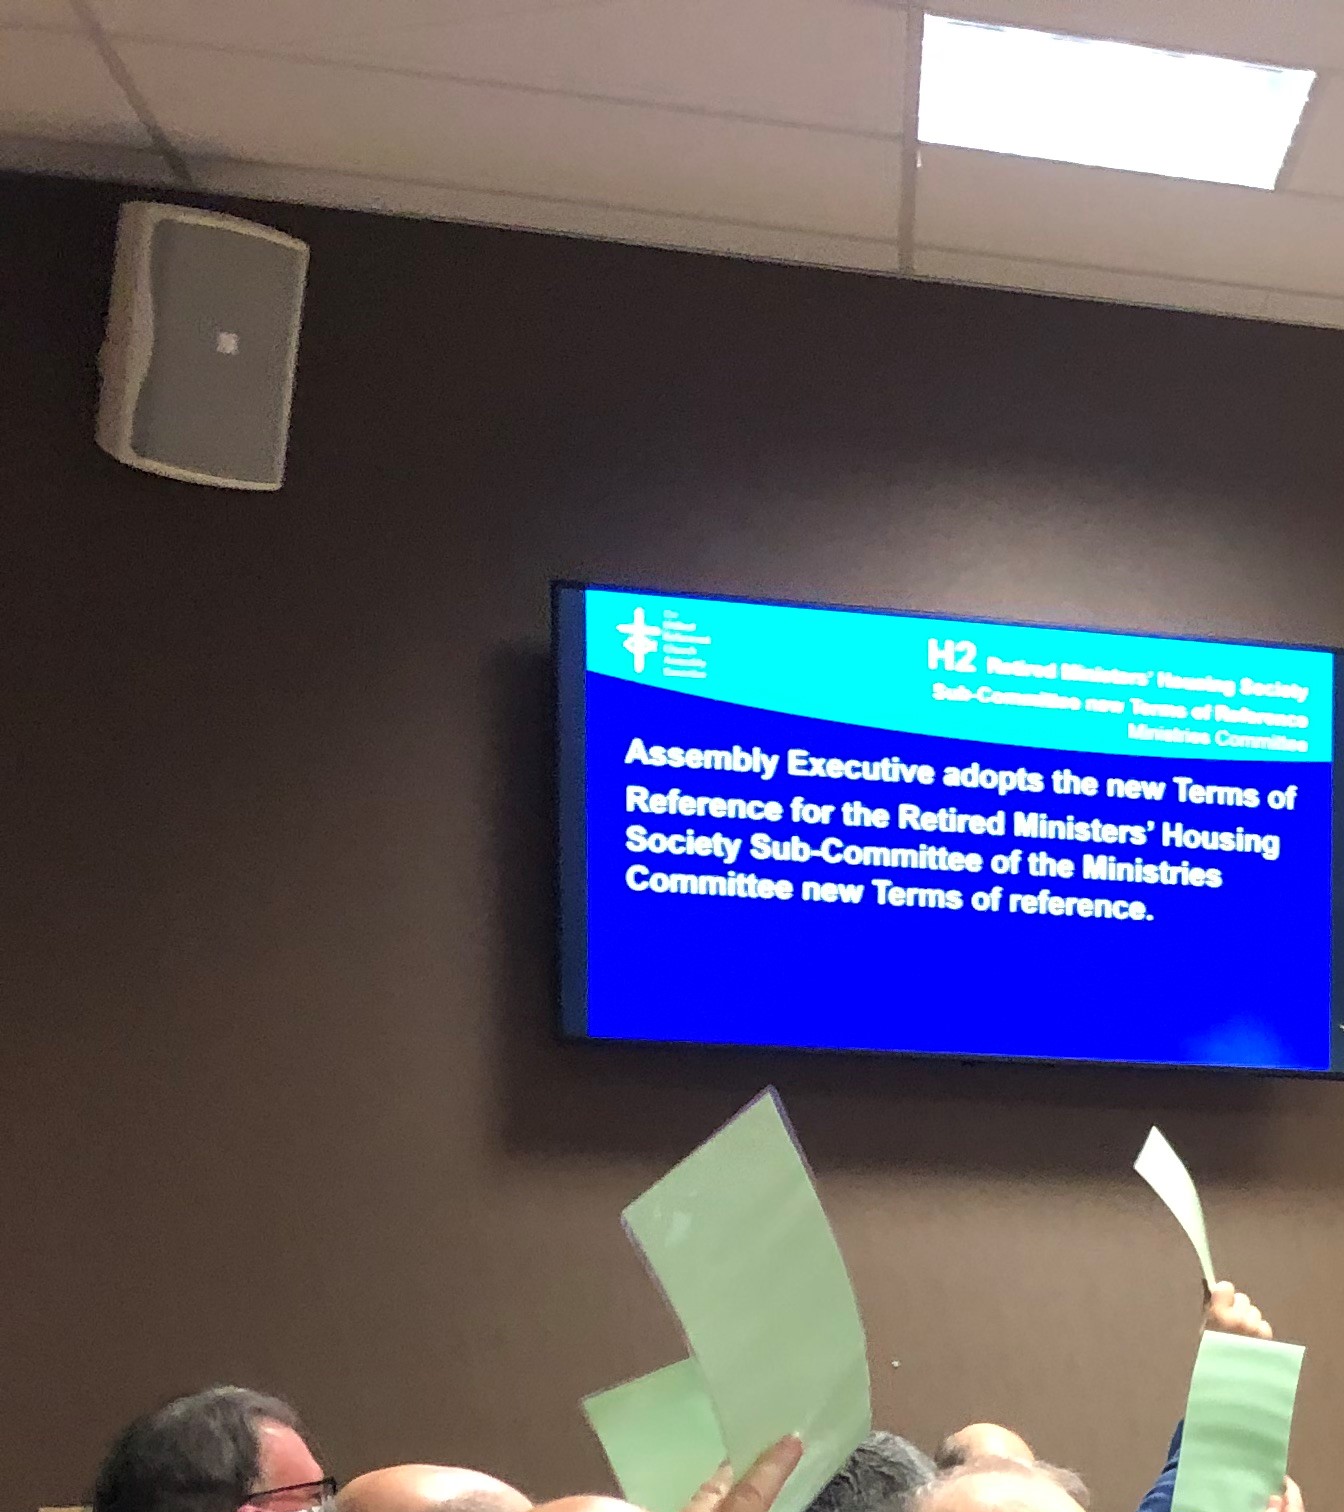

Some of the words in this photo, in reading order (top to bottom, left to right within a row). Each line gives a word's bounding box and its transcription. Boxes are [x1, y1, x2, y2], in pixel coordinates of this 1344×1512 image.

[927, 638, 977, 672] H2
[986, 656, 1056, 678] Retired
[1157, 672, 1236, 697] Housing
[1239, 676, 1309, 703] Society
[932, 682, 1081, 711] Sub-Committee
[1085, 698, 1125, 714] new
[1130, 699, 1187, 718] Terms
[1191, 704, 1212, 721] of
[1214, 705, 1308, 728] Reference
[1128, 722, 1211, 745] Ministries
[1215, 730, 1308, 752] Committee
[624, 737, 779, 780] Assembly
[787, 749, 935, 784] Executive
[942, 762, 1044, 795] adopts
[1052, 769, 1099, 796] the
[1106, 778, 1165, 800] new
[1173, 776, 1260, 808] Terms
[1267, 785, 1298, 810] of
[625, 785, 783, 821] Reference
[791, 796, 835, 824] for
[841, 802, 890, 828] the
[898, 803, 1005, 836] Retired
[1013, 812, 1155, 845] Ministers'
[1162, 822, 1280, 860] Housing
[625, 825, 742, 864] Society
[750, 833, 983, 873] Sub-Committee
[990, 849, 1022, 875] of
[1028, 852, 1075, 878] the
[1083, 854, 1222, 888] Ministries
[625, 865, 794, 899] Committee
[802, 879, 864, 903] new
[871, 879, 963, 910] Terms
[971, 886, 1003, 912] of
[1009, 889, 1154, 921] reference.
